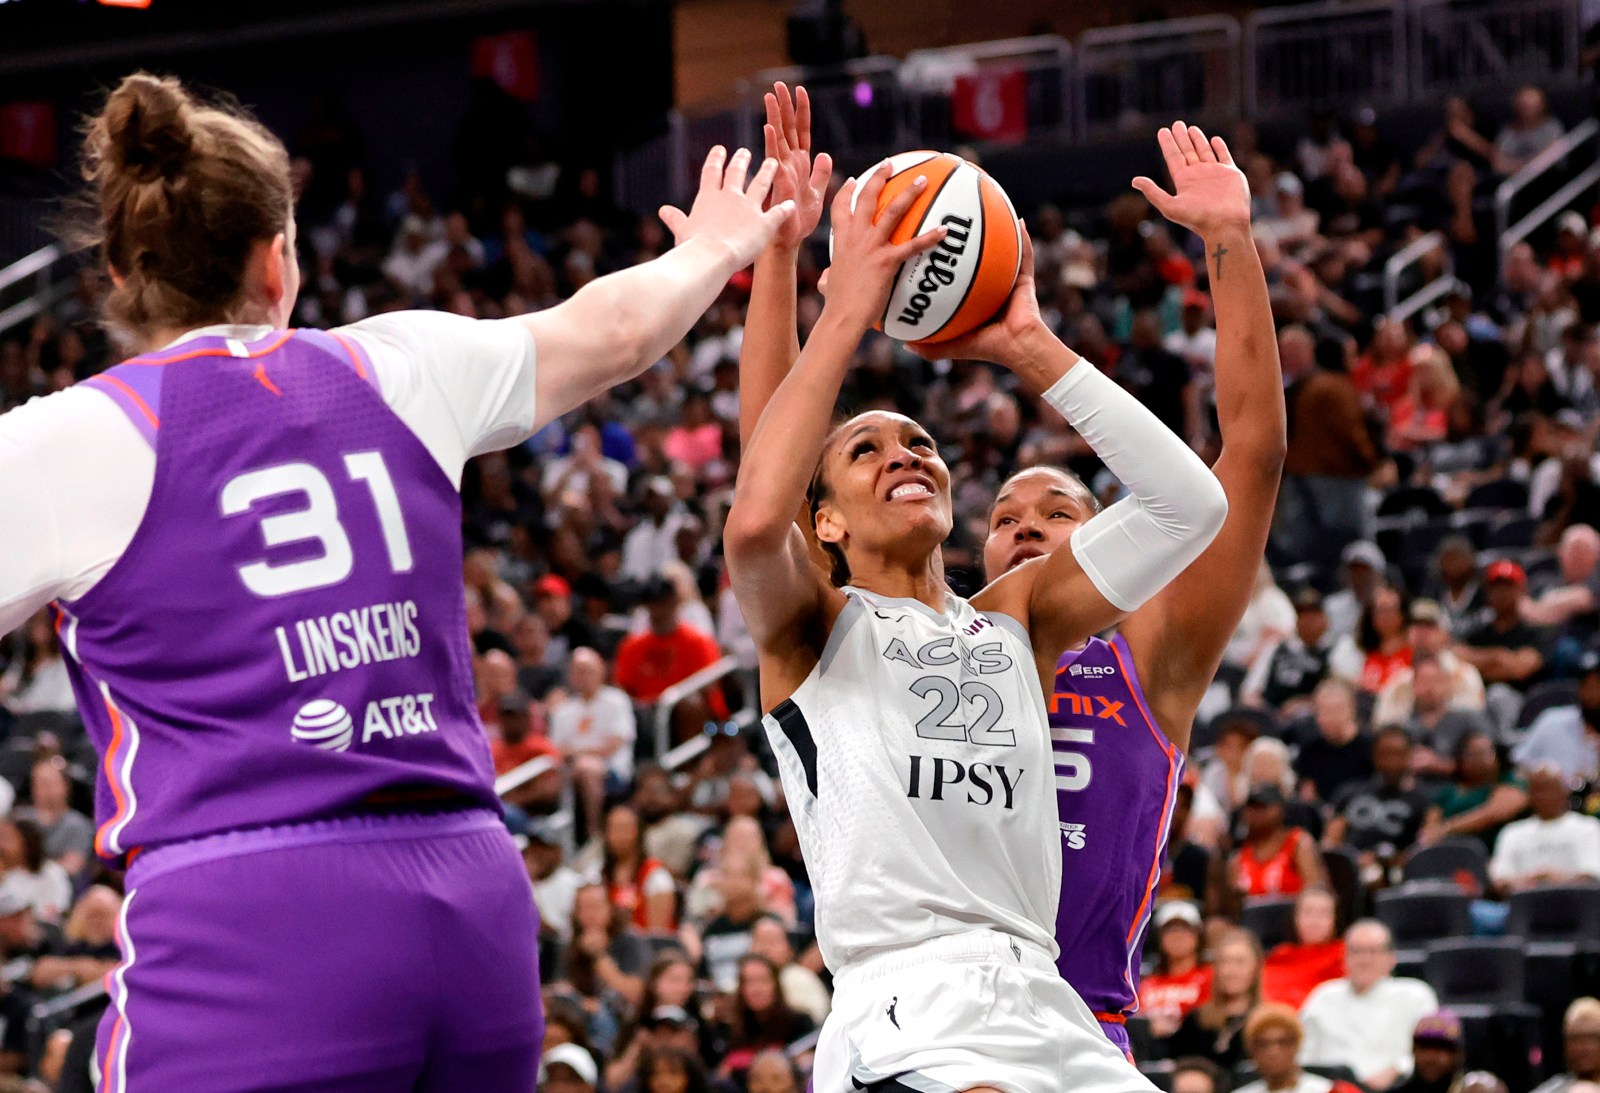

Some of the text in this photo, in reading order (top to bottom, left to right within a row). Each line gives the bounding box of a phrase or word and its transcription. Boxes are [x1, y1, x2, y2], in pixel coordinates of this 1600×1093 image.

[897, 213, 974, 326] Wilson
[220, 451, 413, 597] 31
[276, 600, 421, 682] LINSKENS
[883, 637, 1013, 677] ACES
[362, 693, 437, 743] AT&T
[909, 675, 1016, 747] 22
[907, 755, 1025, 810] IPSY
